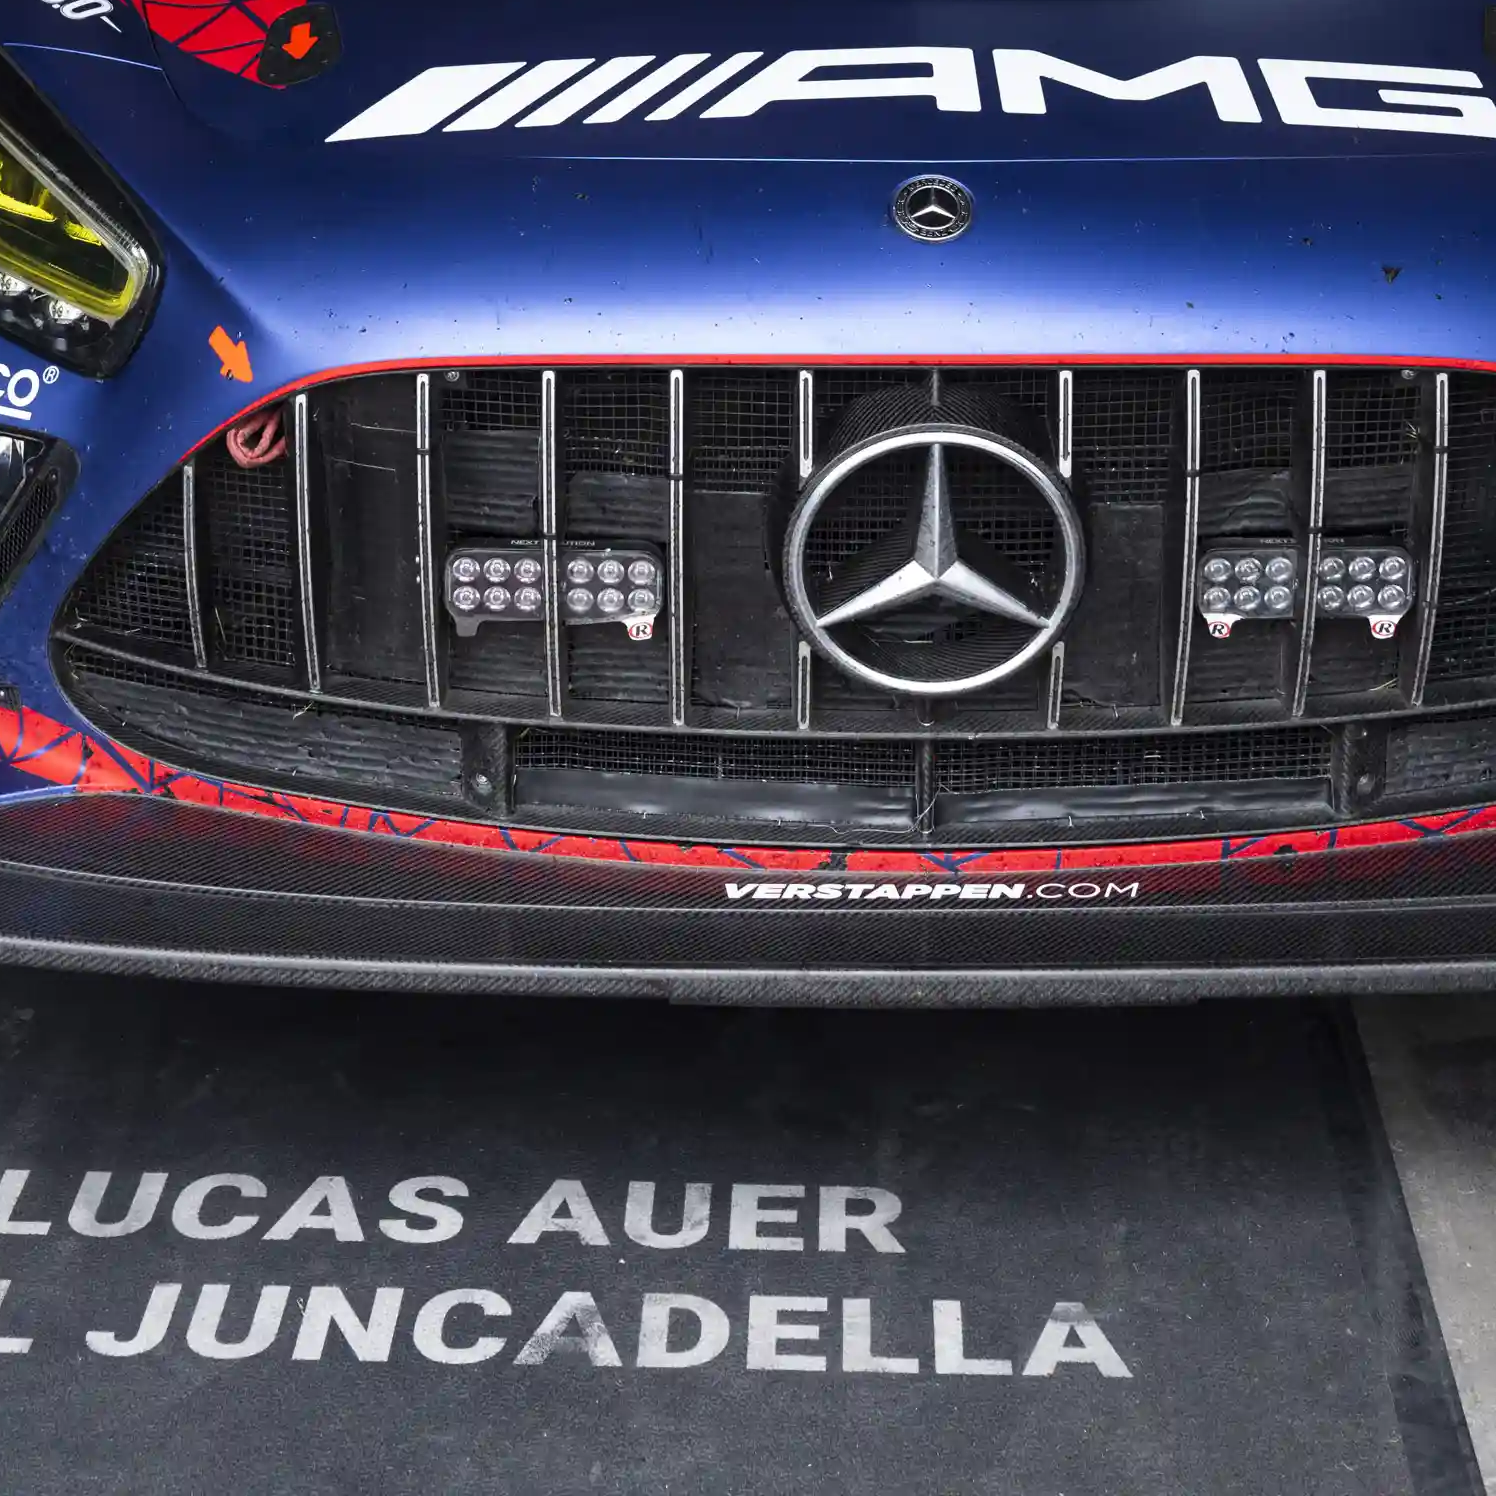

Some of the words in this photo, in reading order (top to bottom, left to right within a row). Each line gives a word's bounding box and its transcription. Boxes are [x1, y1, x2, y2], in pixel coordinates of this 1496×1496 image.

[724, 882, 1141, 901] VERSTAPPEN.COM
[506, 1180, 907, 1256] AUER
[85, 1282, 1135, 1379] JUNCADELLA
